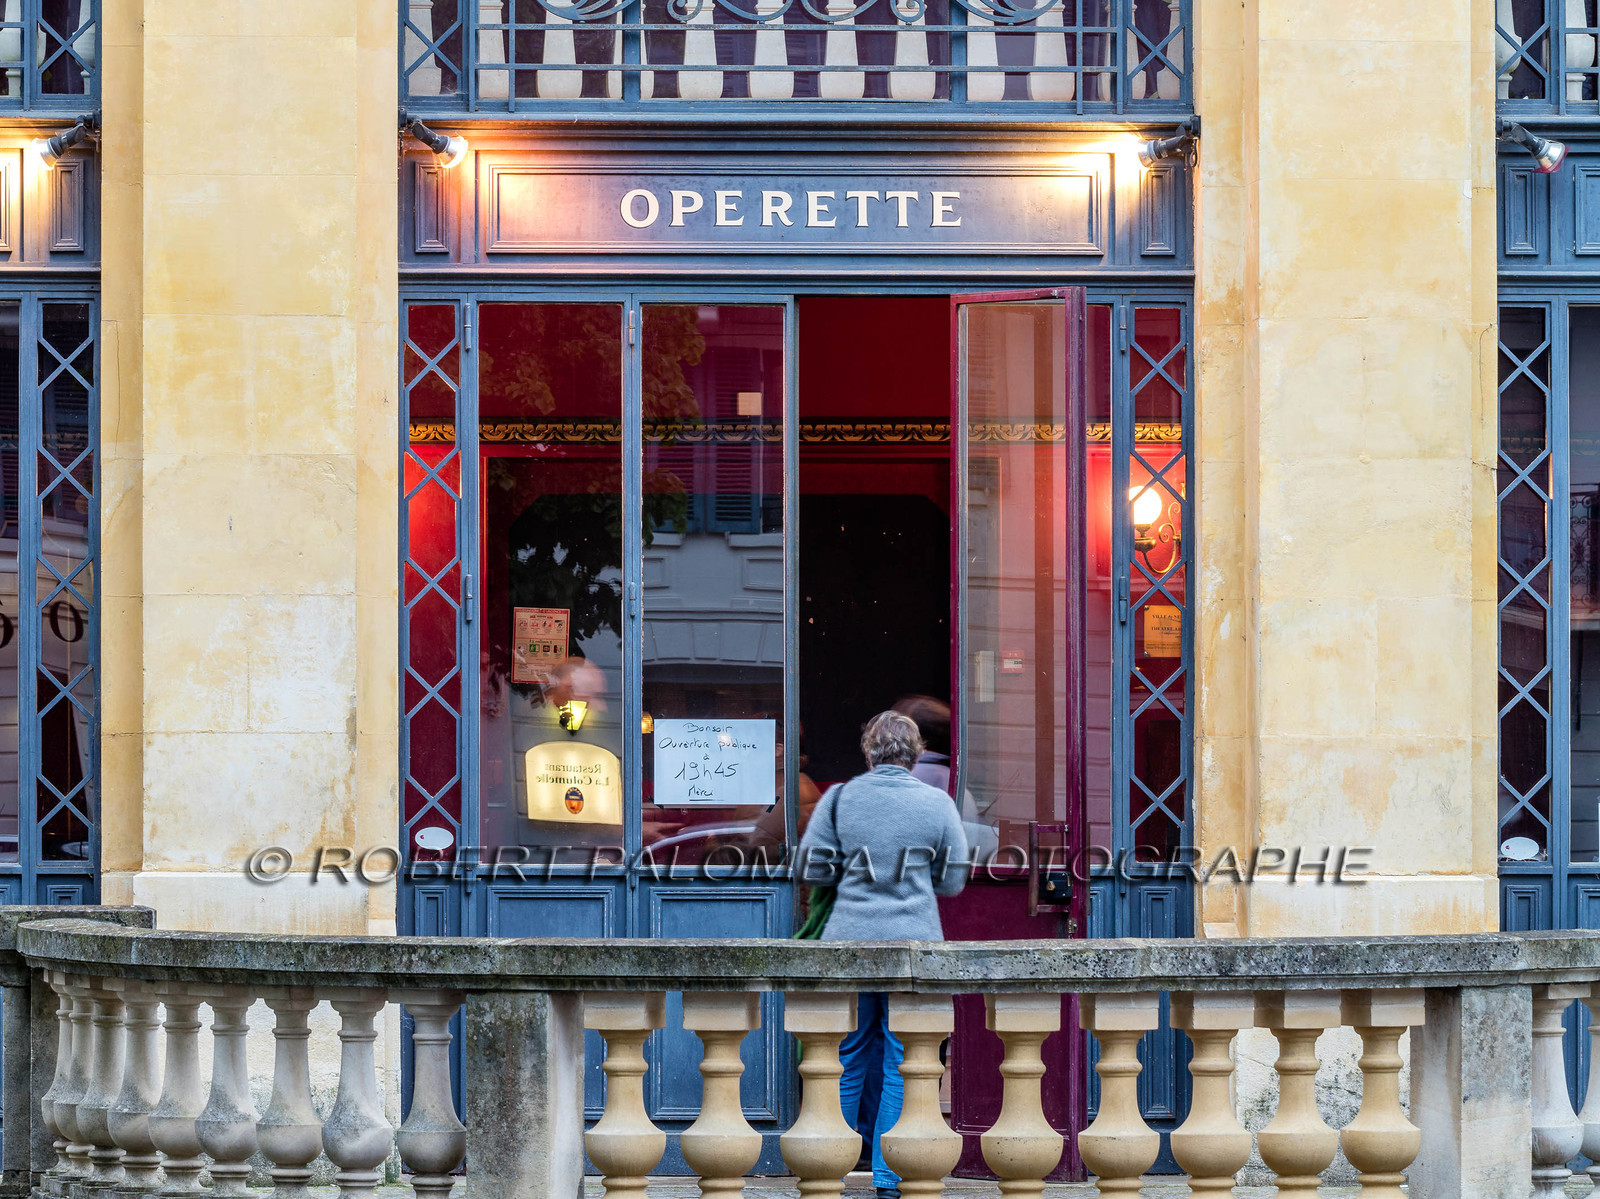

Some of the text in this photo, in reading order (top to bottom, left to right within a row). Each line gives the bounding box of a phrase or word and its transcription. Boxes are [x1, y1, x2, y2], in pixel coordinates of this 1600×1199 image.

[619, 188, 963, 228] OPERETTE
[683, 722, 733, 733] Bonsoir
[718, 738, 757, 751] publique
